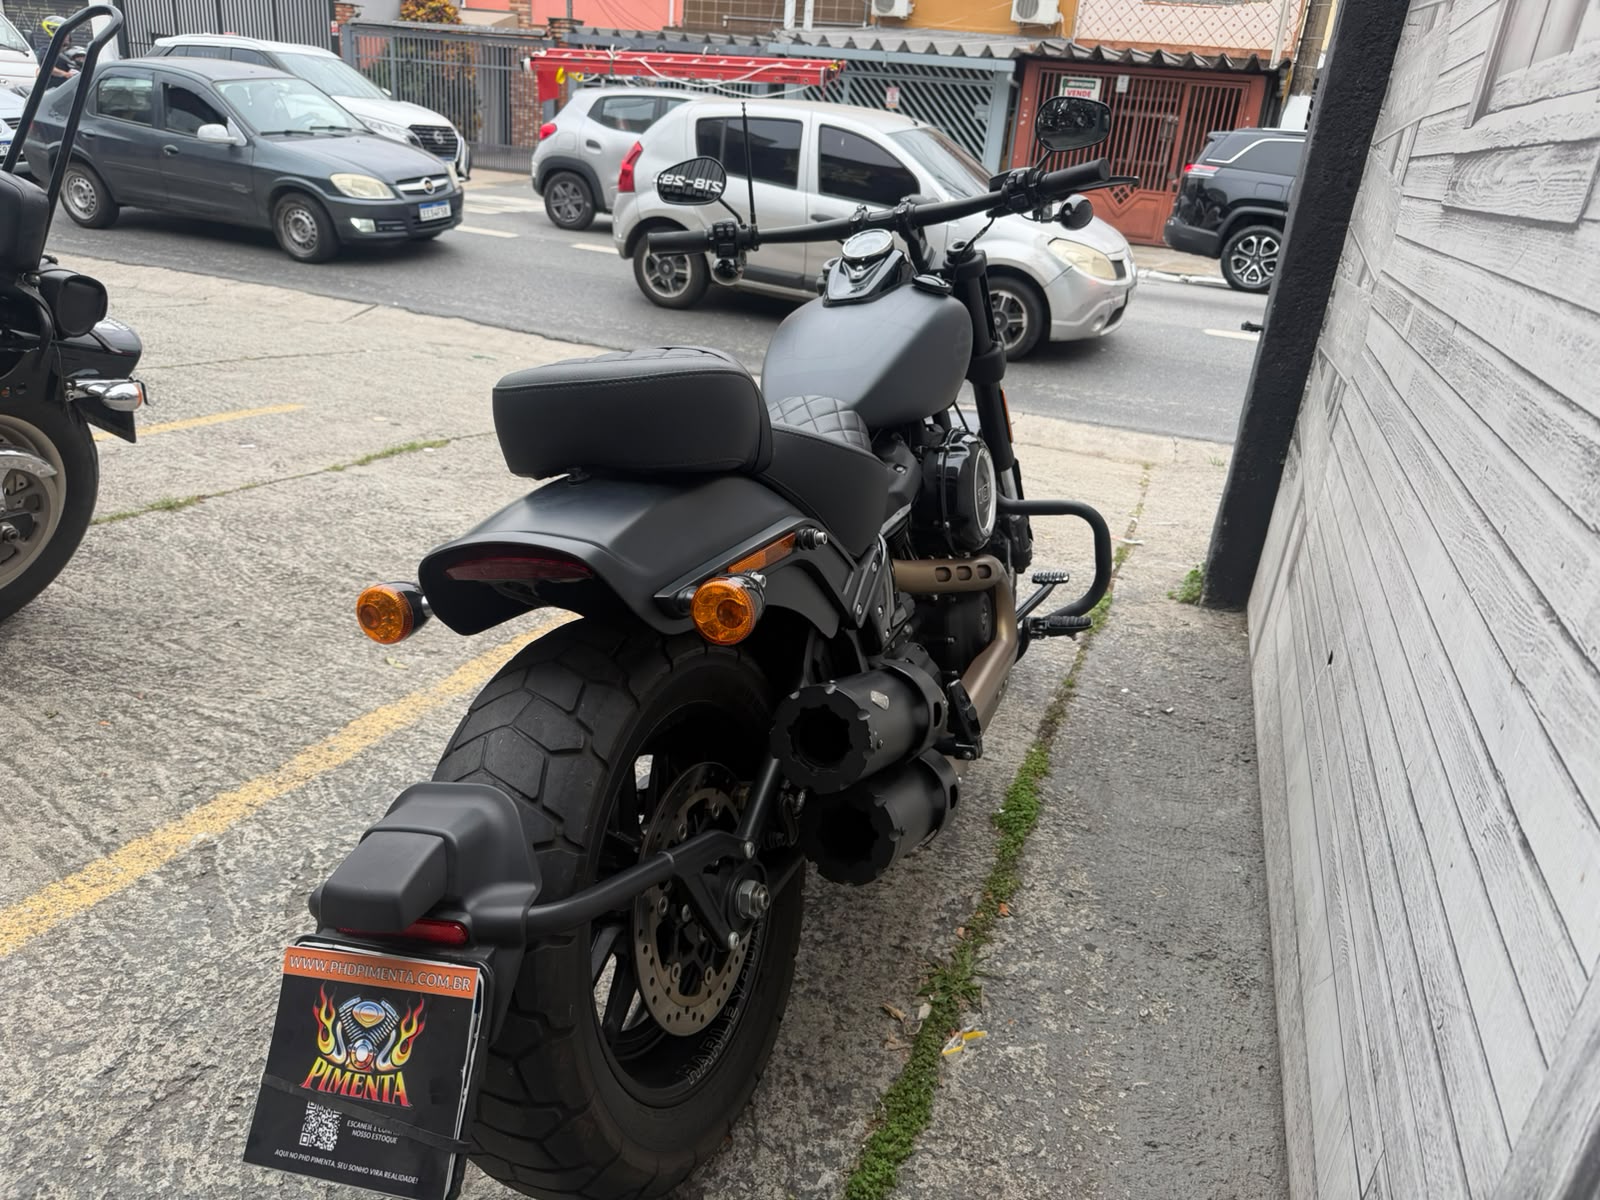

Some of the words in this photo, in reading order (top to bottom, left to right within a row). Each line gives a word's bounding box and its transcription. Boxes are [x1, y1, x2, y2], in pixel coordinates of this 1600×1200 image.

[1066, 89, 1092, 98] VENDE
[289, 955, 471, 992] WWW.PHDPIMENTA.COM.BR
[299, 1057, 413, 1107] PIMENTA
[351, 1129, 371, 1140] NOSSO
[371, 1133, 398, 1144] ESTOQUE
[274, 1149, 289, 1158] AQUI
[289, 1151, 298, 1160] NO
[298, 1153, 311, 1163] PHD
[337, 1160, 349, 1170] SEU
[348, 1163, 369, 1175] SONHO
[369, 1167, 384, 1178] VIRA
[383, 1170, 419, 1185] REALIDADE!
